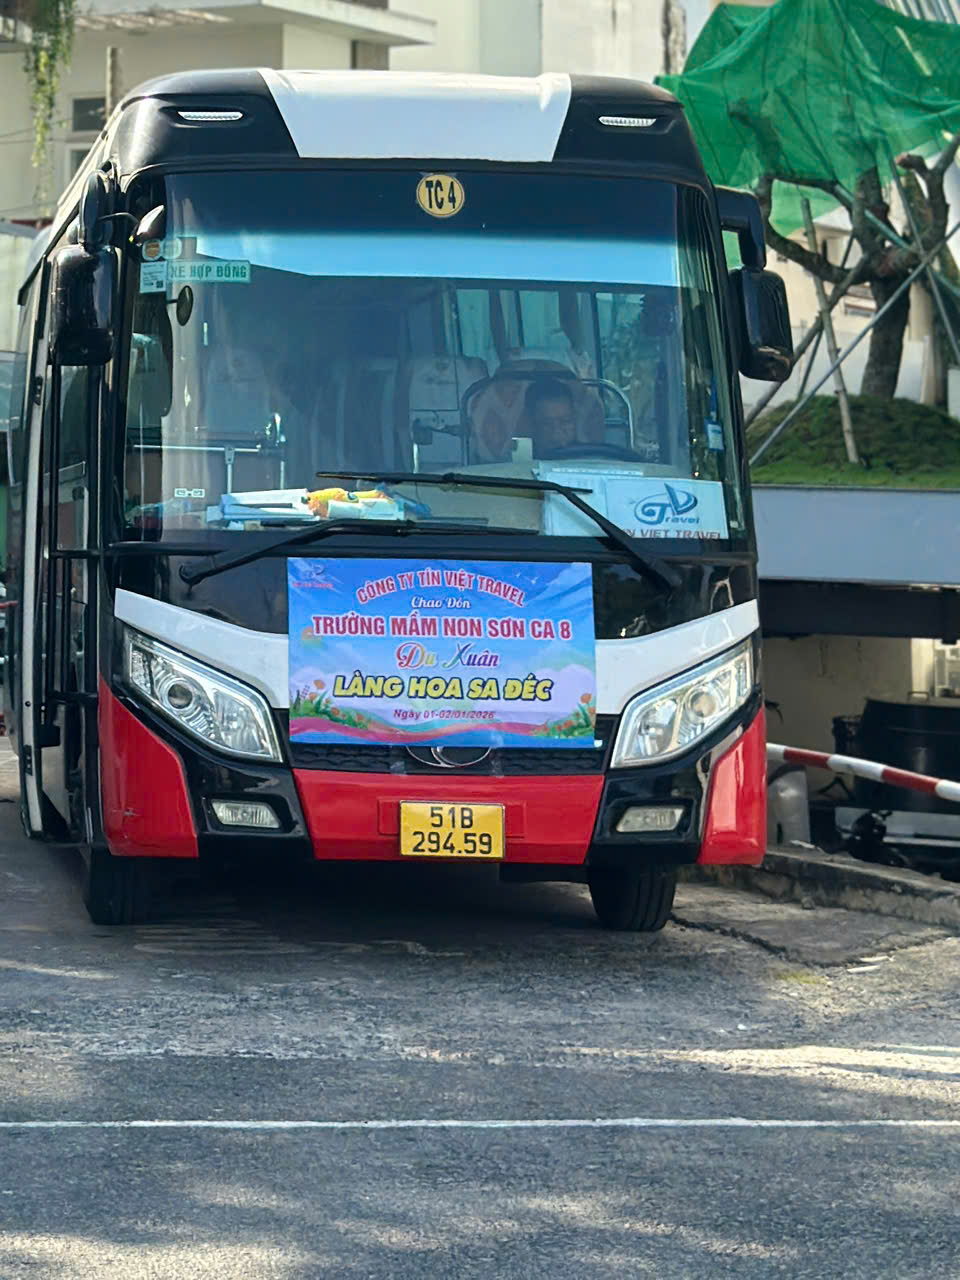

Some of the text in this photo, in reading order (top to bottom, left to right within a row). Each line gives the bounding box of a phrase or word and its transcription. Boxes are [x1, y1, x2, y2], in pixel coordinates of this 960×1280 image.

[170, 265, 186, 278] XE
[357, 567, 524, 607] CÔNG TY TÍN VIỆT TRAVEL
[312, 610, 571, 639] TRƯỜNG MẦM NON SƠN CA 8
[396, 641, 499, 669] Du Xuân
[333, 670, 553, 700] LÀNG HOA SA ĐÉC
[393, 708, 421, 720] Ngày
[431, 806, 474, 829] 51B
[412, 831, 493, 855] 294.59
